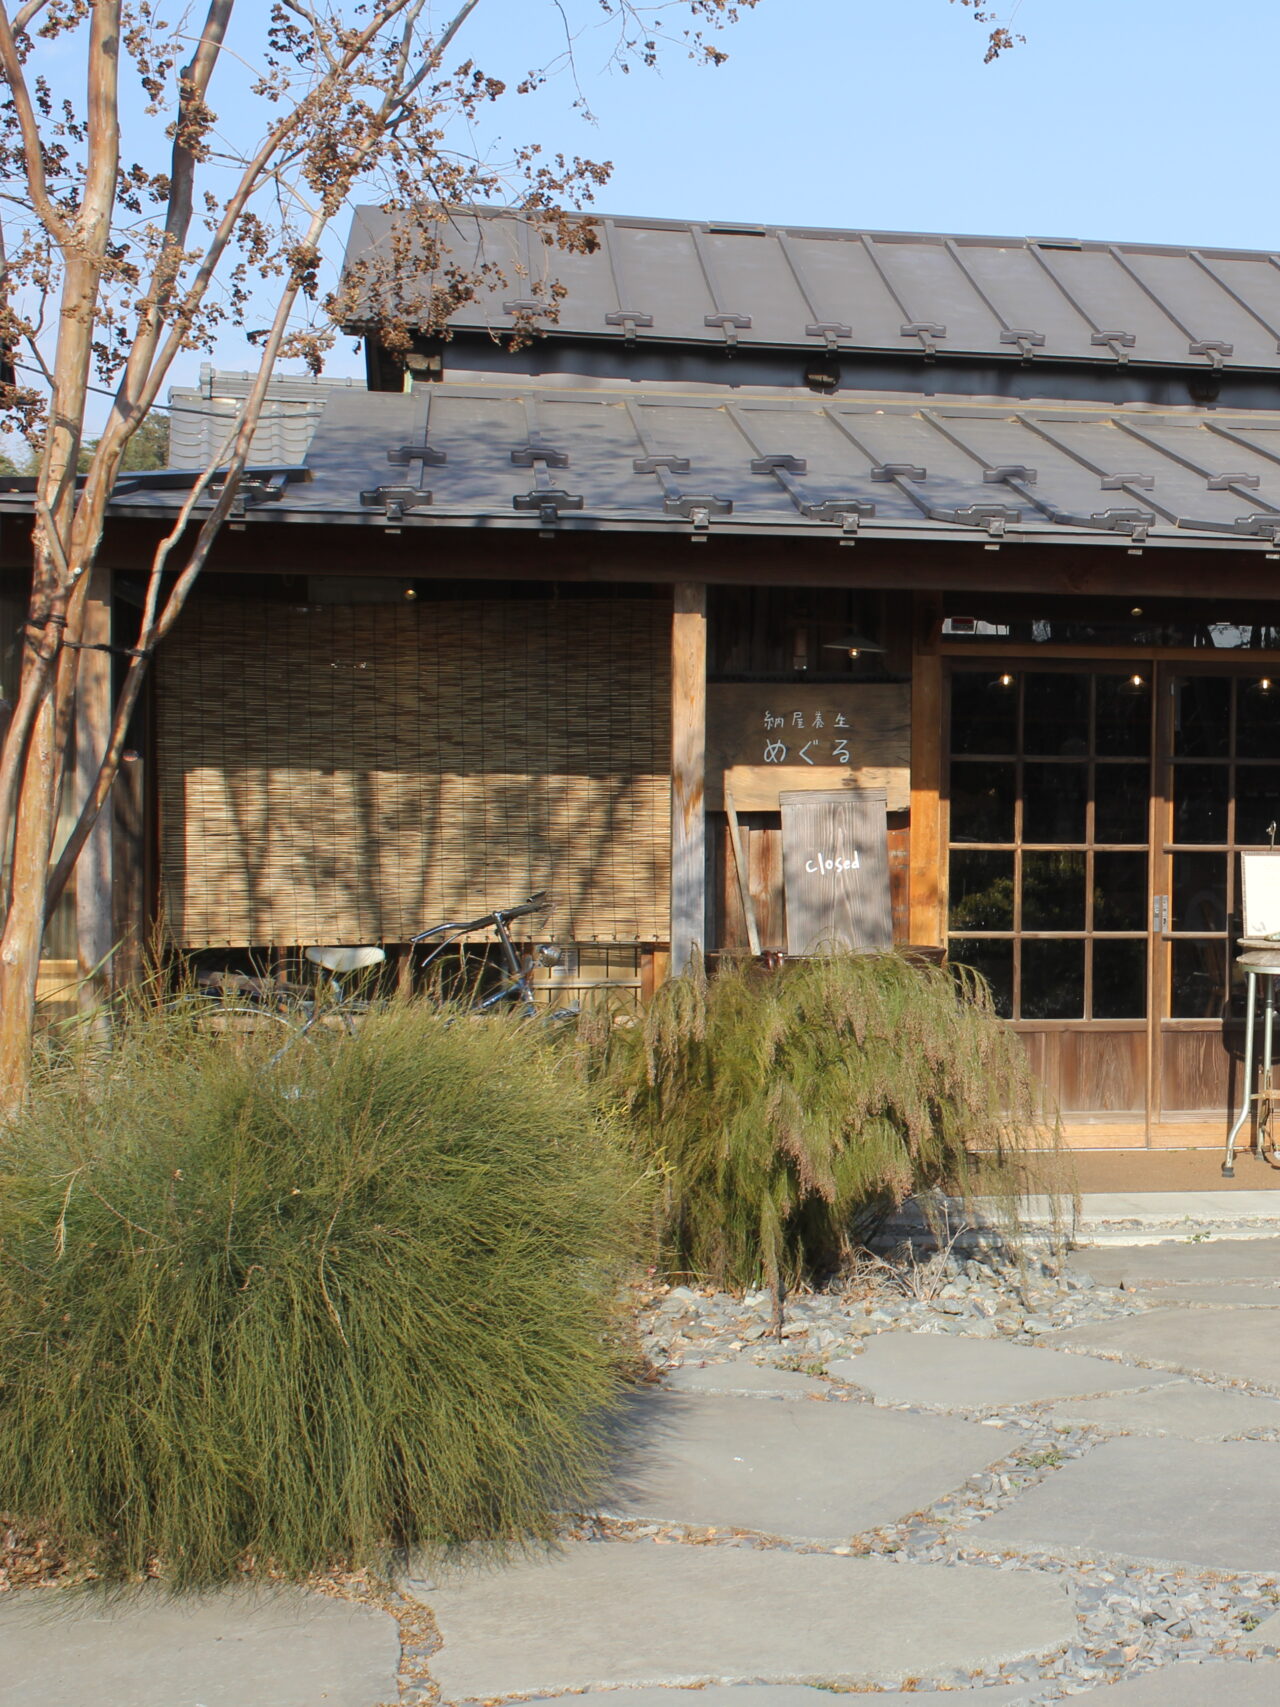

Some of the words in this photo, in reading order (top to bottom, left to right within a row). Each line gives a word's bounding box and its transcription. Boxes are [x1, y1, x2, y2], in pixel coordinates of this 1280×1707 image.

[764, 739, 850, 765] めぐる
[805, 850, 860, 876] closed
